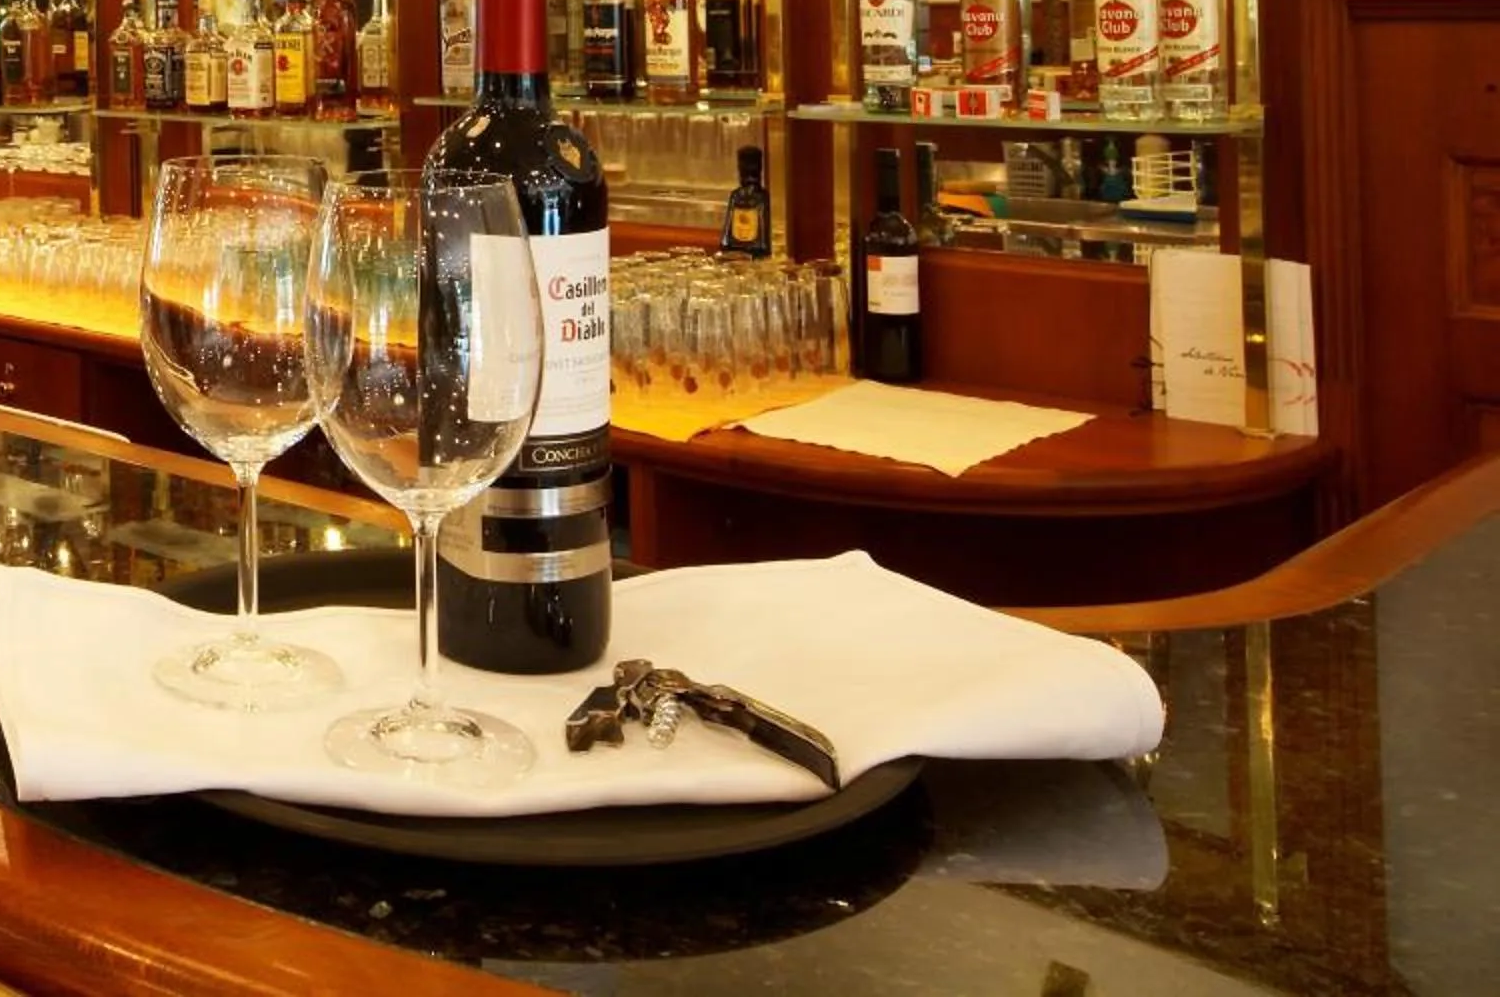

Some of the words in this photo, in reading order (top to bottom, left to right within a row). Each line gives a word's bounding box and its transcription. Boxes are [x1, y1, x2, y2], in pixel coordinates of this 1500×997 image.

[1099, 9, 1144, 20] avana
[1101, 21, 1132, 34] Club
[581, 301, 595, 317] del
